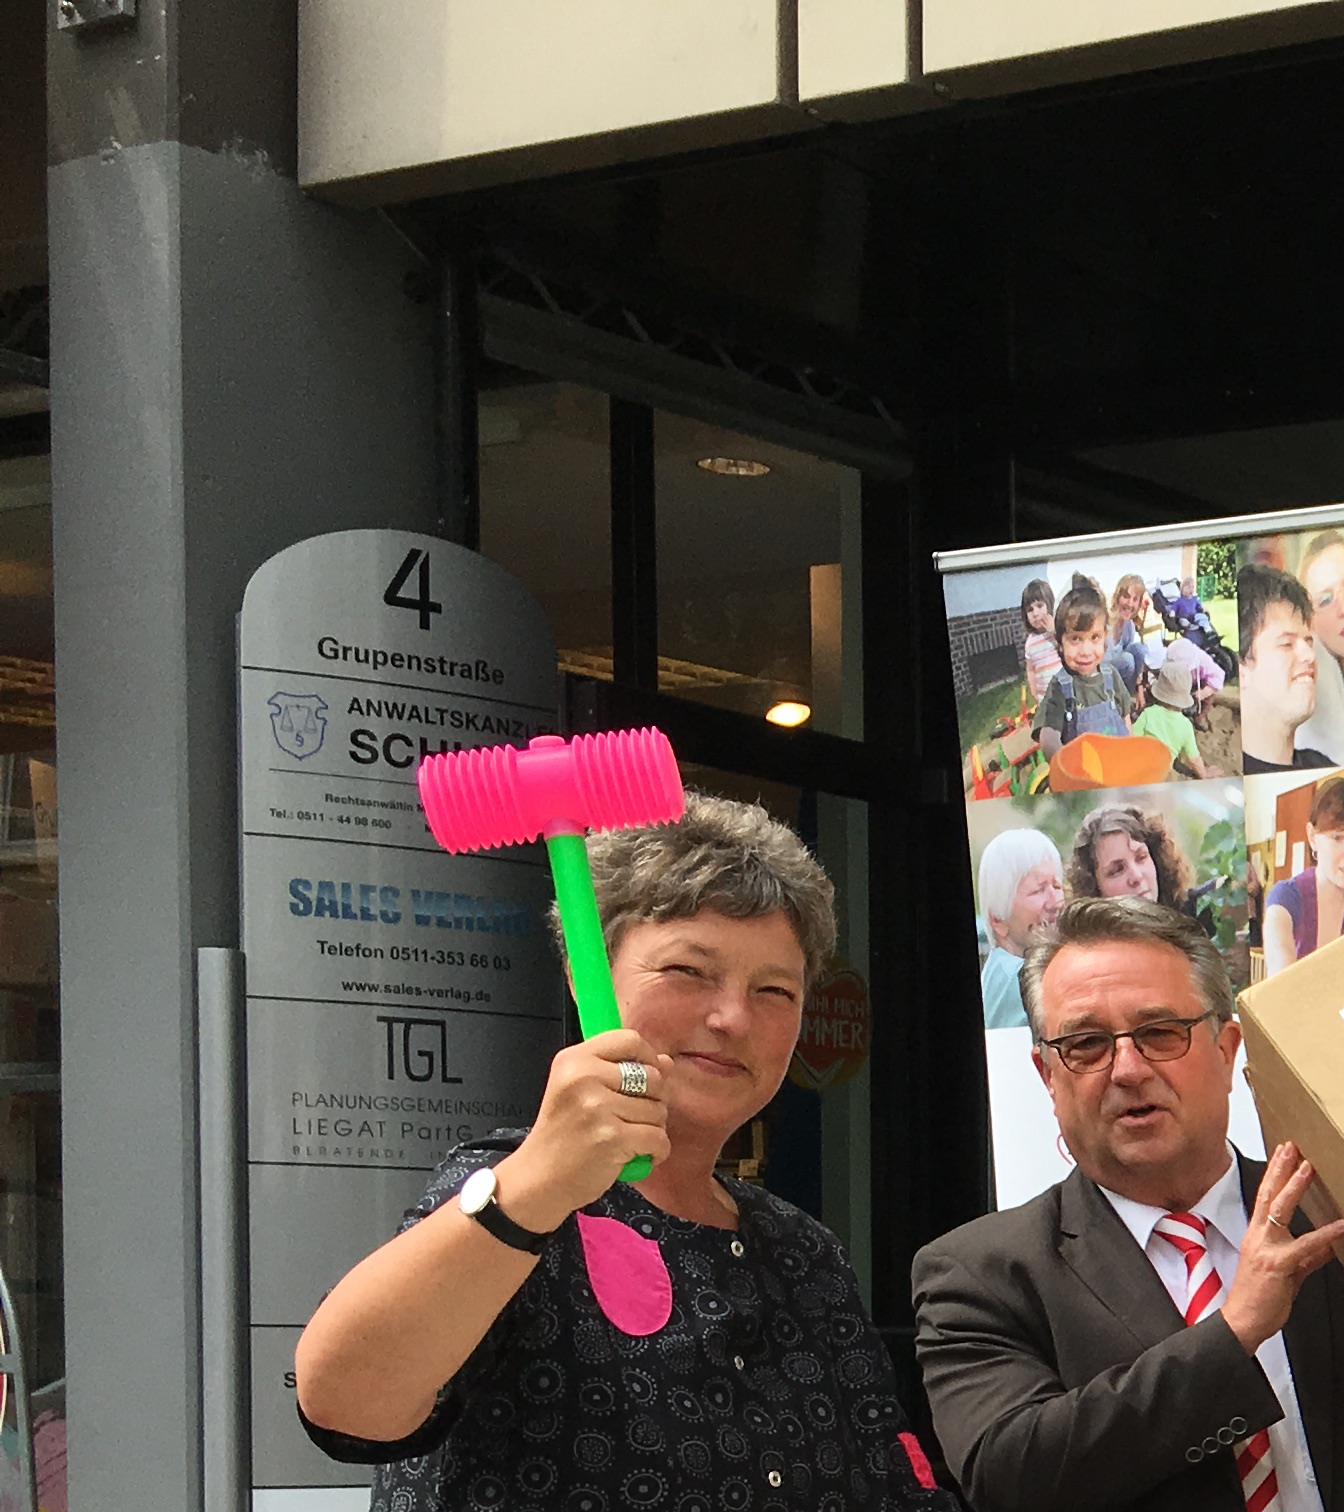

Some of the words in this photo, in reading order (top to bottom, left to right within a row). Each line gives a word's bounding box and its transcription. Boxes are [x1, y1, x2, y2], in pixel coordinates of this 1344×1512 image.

[383, 547, 442, 631] 4
[317, 635, 506, 686] Grupenstraße
[288, 877, 403, 926] SALES
[316, 939, 385, 960] Telefon
[389, 945, 466, 967] 0511-353
[470, 952, 490, 969] 66
[341, 980, 492, 1005] www.sales-verlag.de
[376, 1014, 464, 1085] TGL
[291, 1117, 388, 1139] LIEGAT
[400, 1120, 475, 1143] PartG
